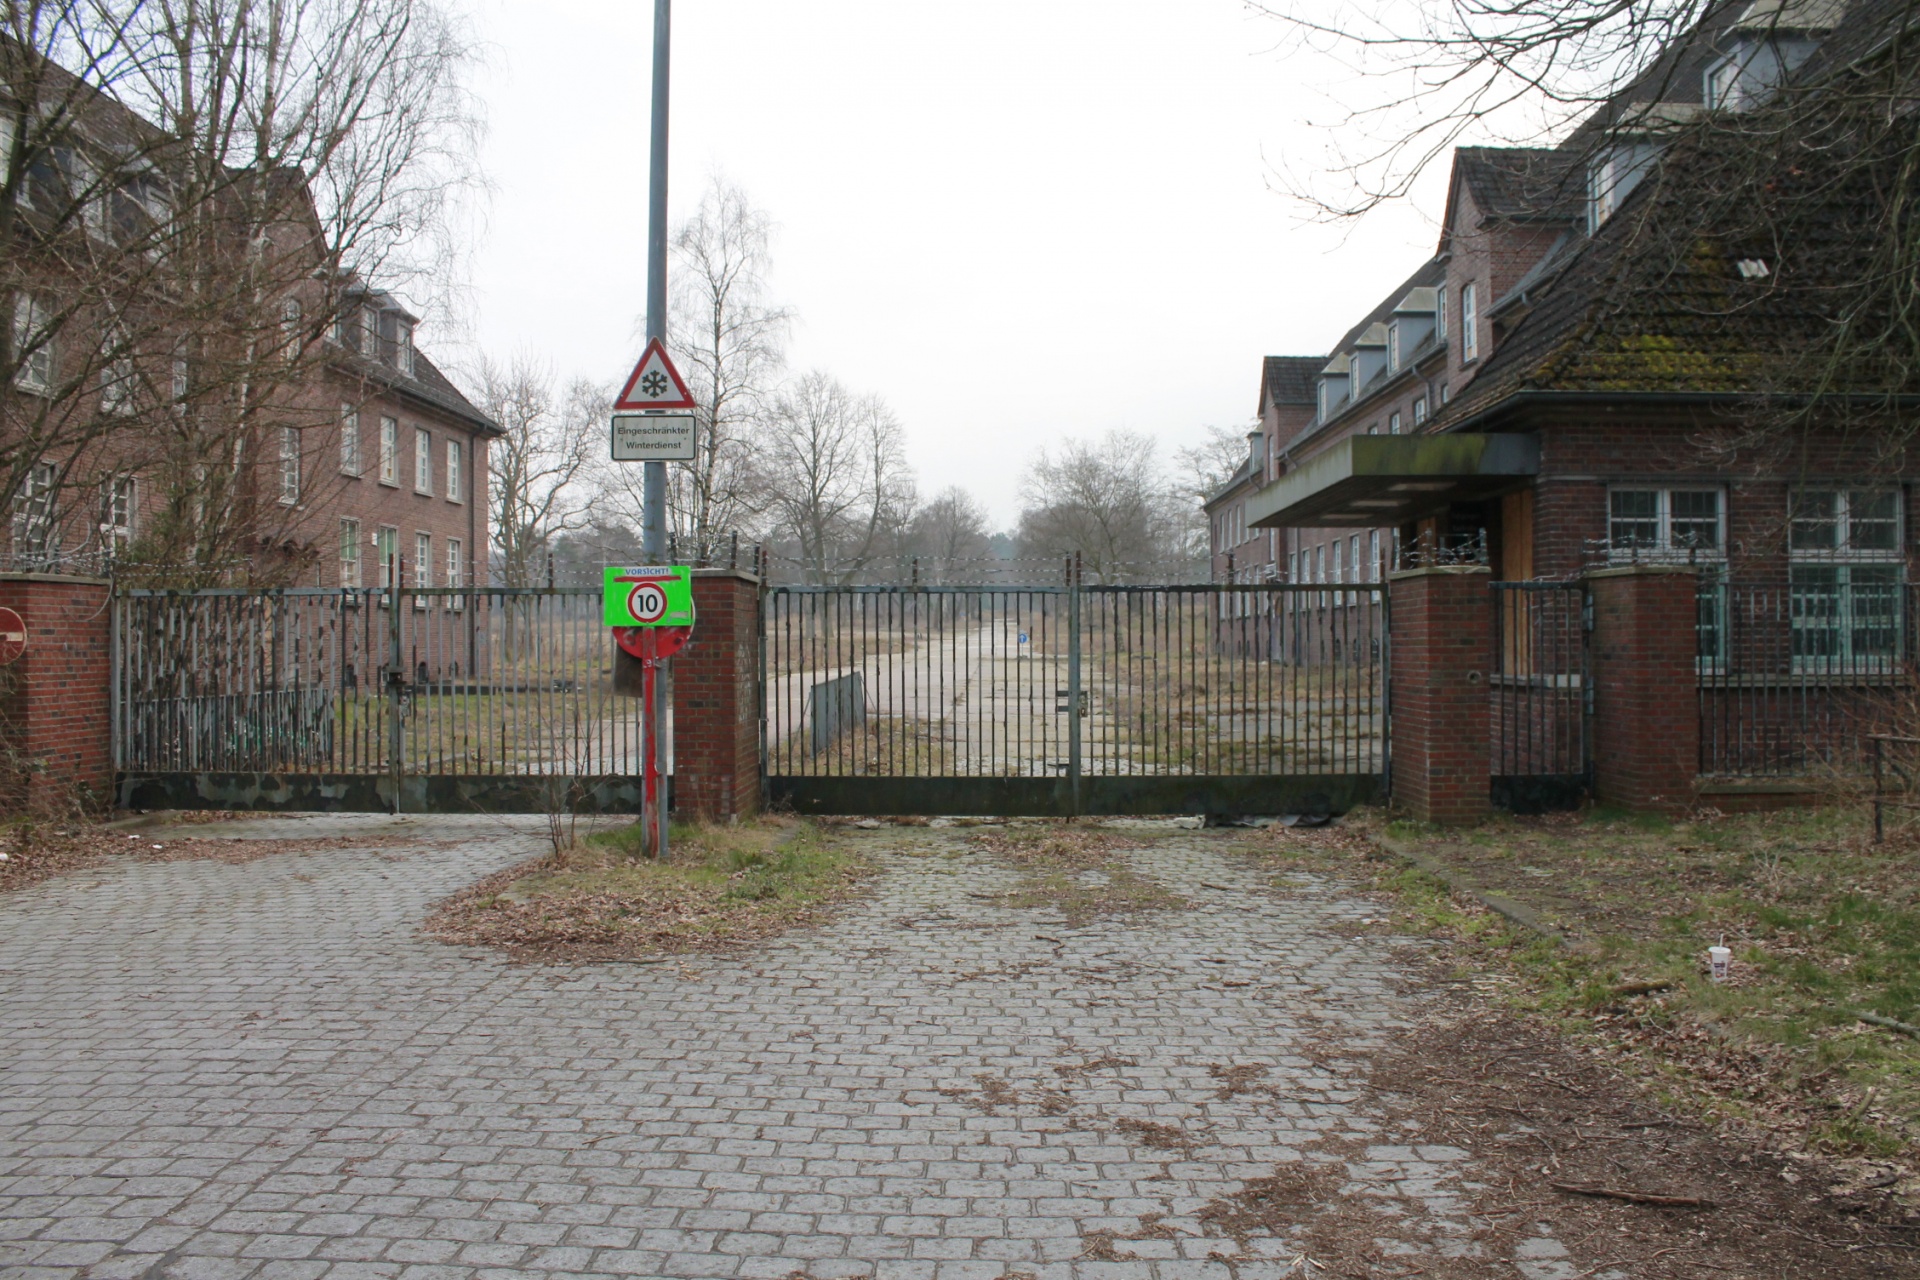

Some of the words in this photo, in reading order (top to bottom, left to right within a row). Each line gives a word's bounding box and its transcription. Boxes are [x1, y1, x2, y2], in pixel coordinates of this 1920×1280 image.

[617, 426, 690, 437] Eingeschränkter
[626, 441, 682, 449] Winterdienst
[625, 567, 669, 575] VORSICHT!
[637, 594, 658, 613] 10
